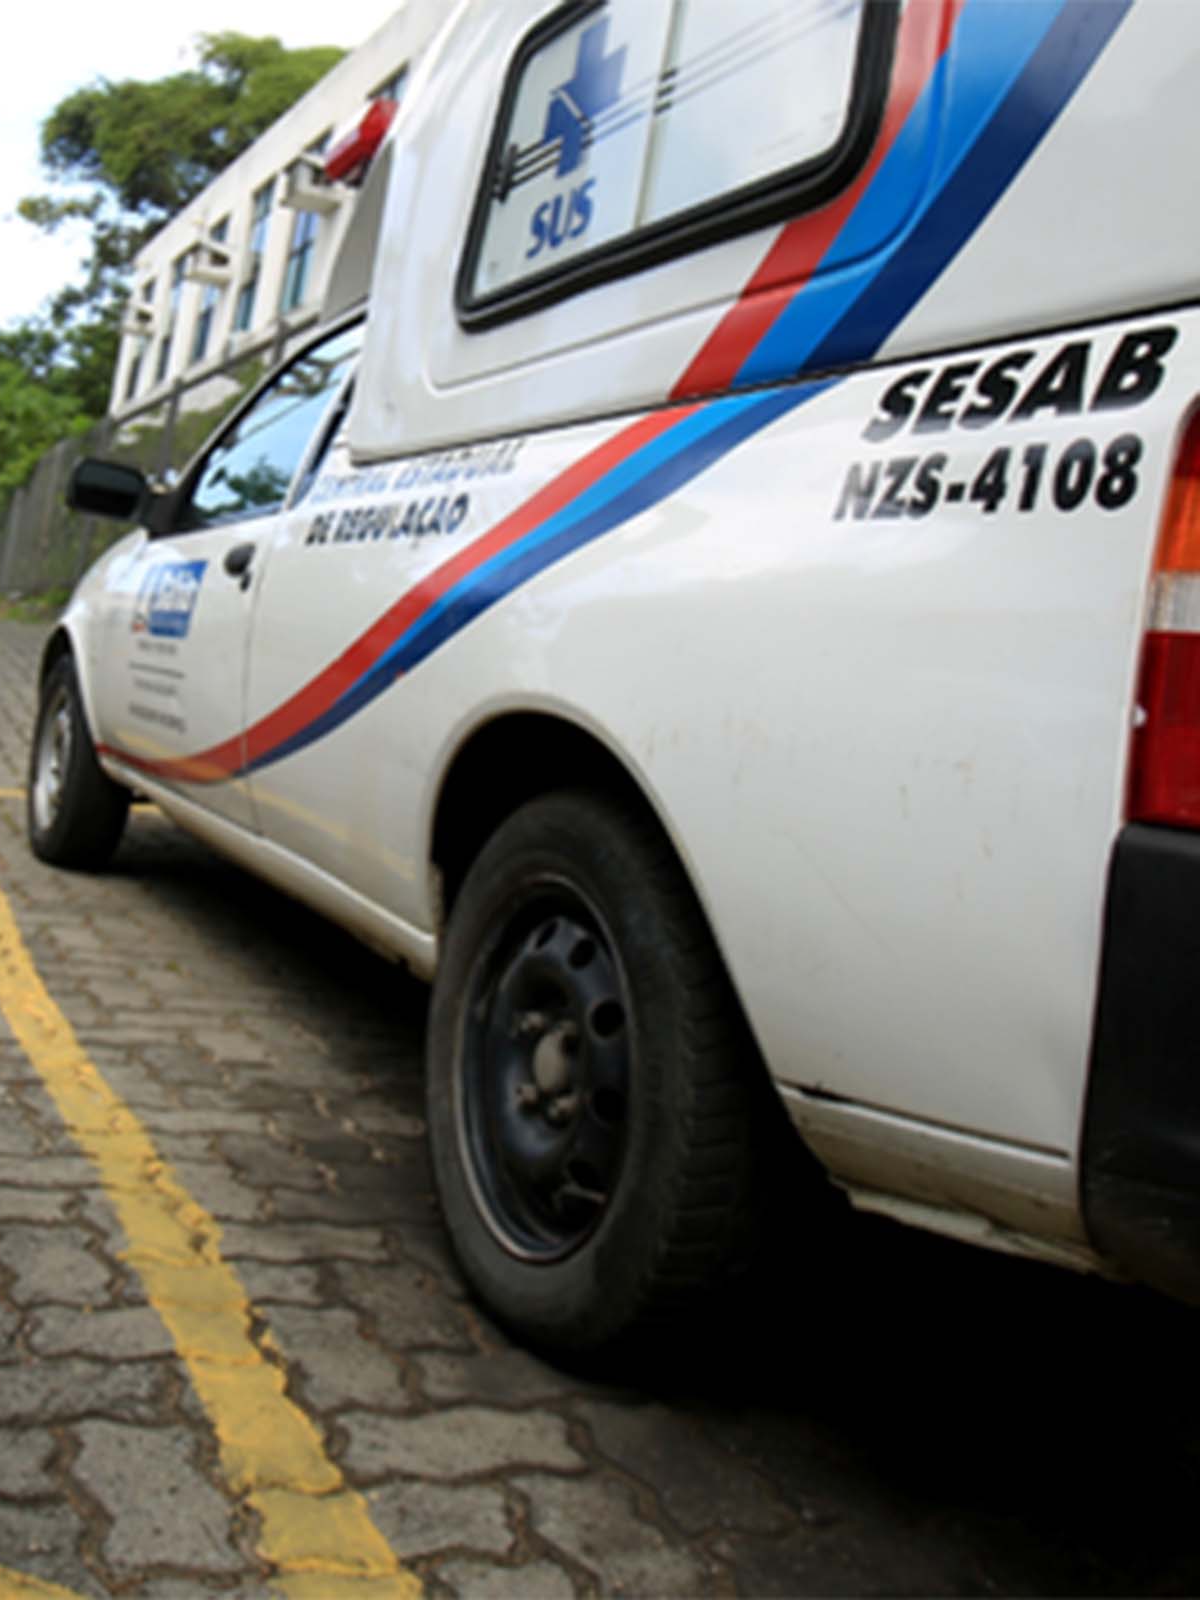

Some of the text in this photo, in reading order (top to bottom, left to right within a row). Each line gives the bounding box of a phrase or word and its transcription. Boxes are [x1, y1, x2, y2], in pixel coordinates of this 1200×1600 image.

[526, 179, 596, 259] SUS
[861, 325, 1179, 444] SESAB
[833, 433, 1143, 522] NZS-4108
